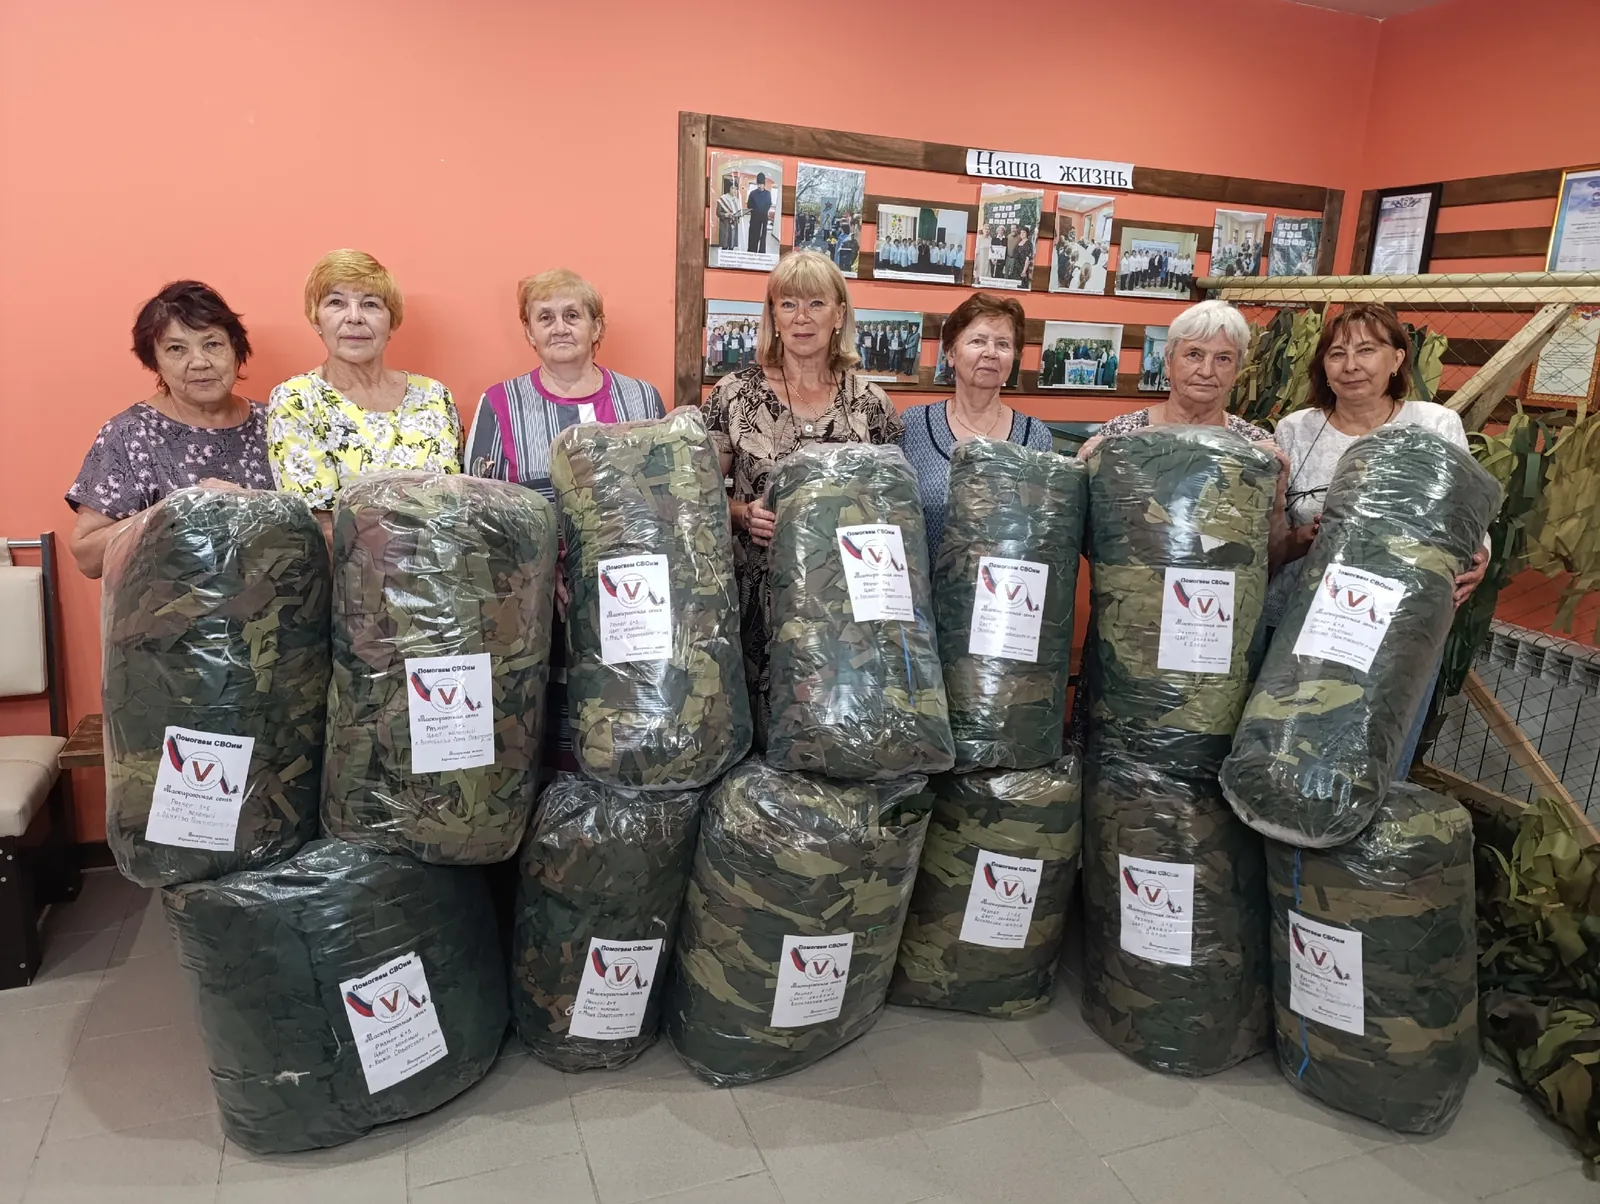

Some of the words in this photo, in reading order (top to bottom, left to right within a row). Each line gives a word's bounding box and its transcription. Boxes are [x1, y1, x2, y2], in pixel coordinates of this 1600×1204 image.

[975, 151, 1042, 179] Наша
[1059, 165, 1128, 186] жизнь
[1020, 566, 1040, 574] СВОим
[1370, 579, 1394, 591] СВОим
[418, 666, 450, 674] Помогаем
[418, 715, 463, 723] Маскировочная
[176, 733, 212, 745] Помогаем
[214, 741, 242, 749] СВОим
[164, 785, 213, 800] Маскировочная
[991, 862, 1017, 870] Помогаем
[1129, 865, 1156, 874] Помогаем
[1296, 923, 1321, 937] Помогаем
[1323, 934, 1345, 944] СВОим
[352, 972, 388, 991] Помогаем
[389, 960, 412, 975] СВОим
[587, 988, 628, 998] Маскировочная
[365, 1017, 412, 1043] Маскировочная
